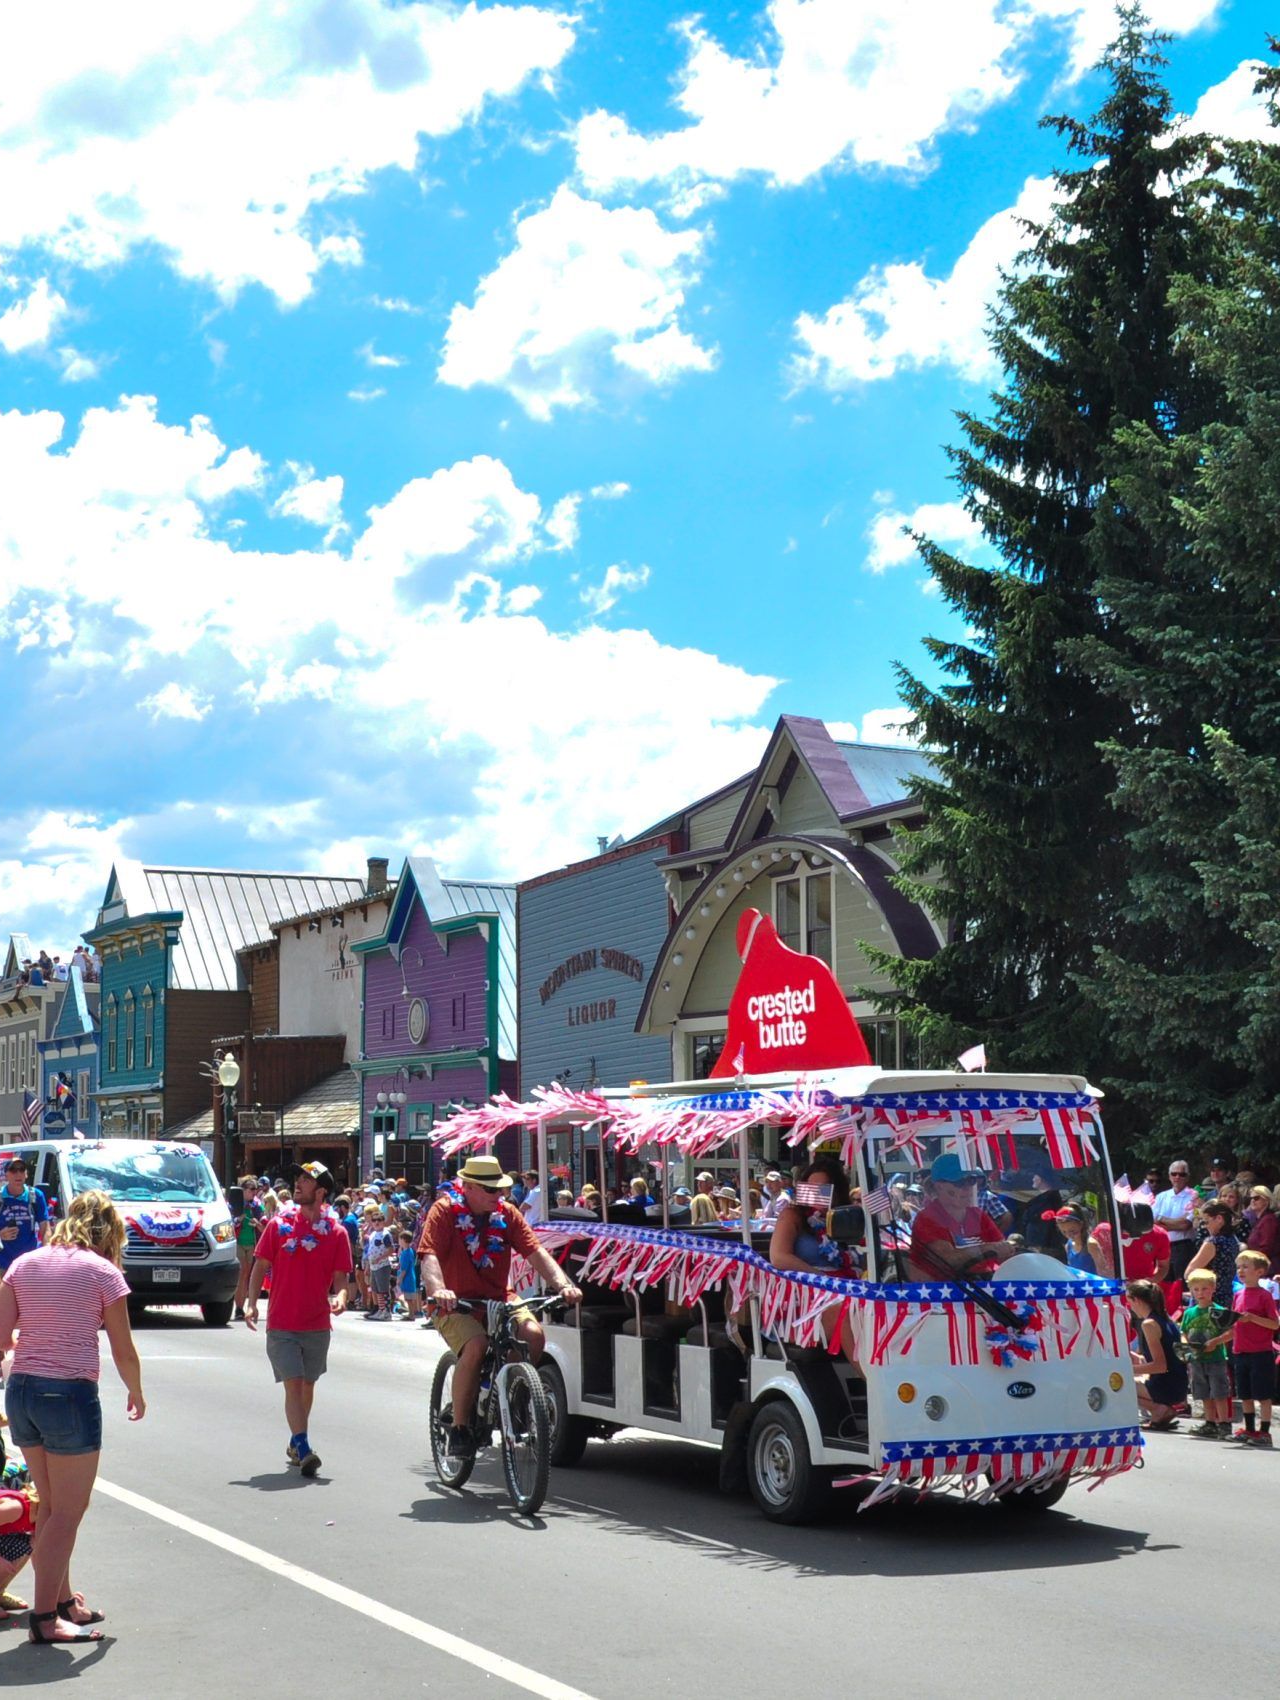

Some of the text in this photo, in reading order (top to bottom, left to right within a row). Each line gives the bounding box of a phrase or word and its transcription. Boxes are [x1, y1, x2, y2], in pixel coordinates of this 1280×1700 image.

[539, 948, 644, 1005] MOUNTAIN SPIRITS
[568, 999, 616, 1026] LIQUOR
[747, 979, 814, 1022] crested
[759, 1021, 806, 1049] butte
[1009, 1384, 1034, 1395] Star
